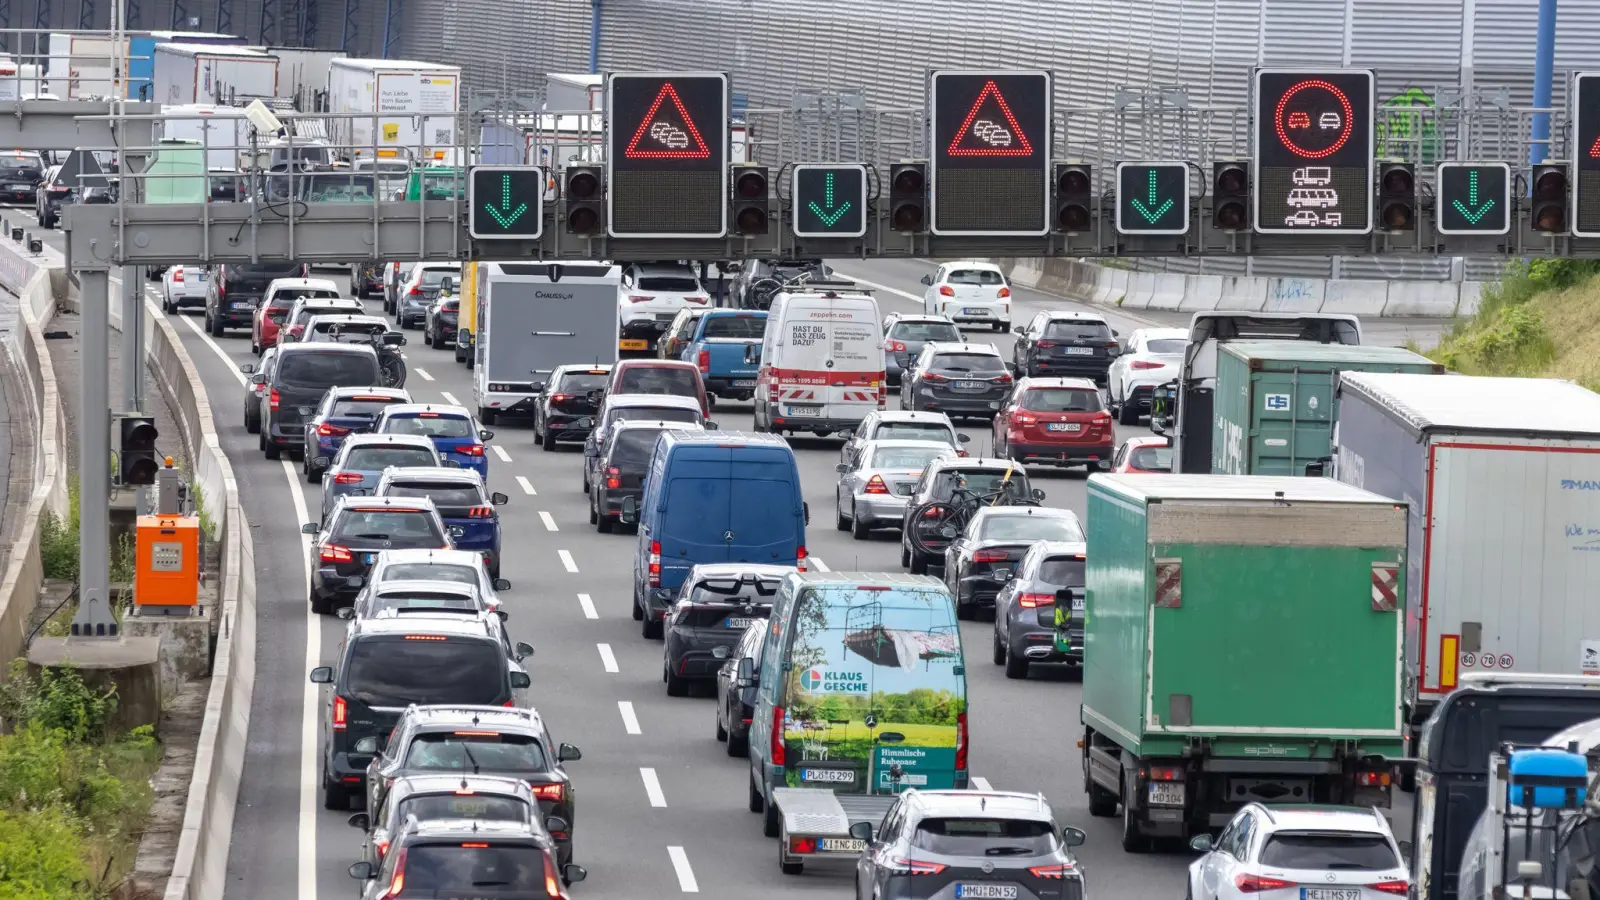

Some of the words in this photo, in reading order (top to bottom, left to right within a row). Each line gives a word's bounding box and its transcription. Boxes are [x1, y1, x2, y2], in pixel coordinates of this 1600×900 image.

[810, 311, 853, 319] zeppelin.com
[793, 325, 812, 333] HAST
[1463, 655, 1473, 664] 60
[1484, 656, 1493, 665] 70
[1501, 657, 1511, 666] 80
[824, 671, 863, 681] KLAUS
[823, 682, 868, 691] GESCHE
[881, 748, 926, 757] Himmlische
[881, 757, 917, 766] Ruheoase
[807, 769, 824, 779] PLÖ
[836, 771, 853, 780] 299
[823, 840, 833, 849] KI
[839, 841, 851, 849] NC
[962, 884, 983, 897] HMÜ
[988, 885, 1002, 897] BN
[1003, 885, 1017, 897] 52
[1306, 890, 1324, 900] HEI
[1331, 891, 1344, 900] MS
[1346, 891, 1358, 900] 97
